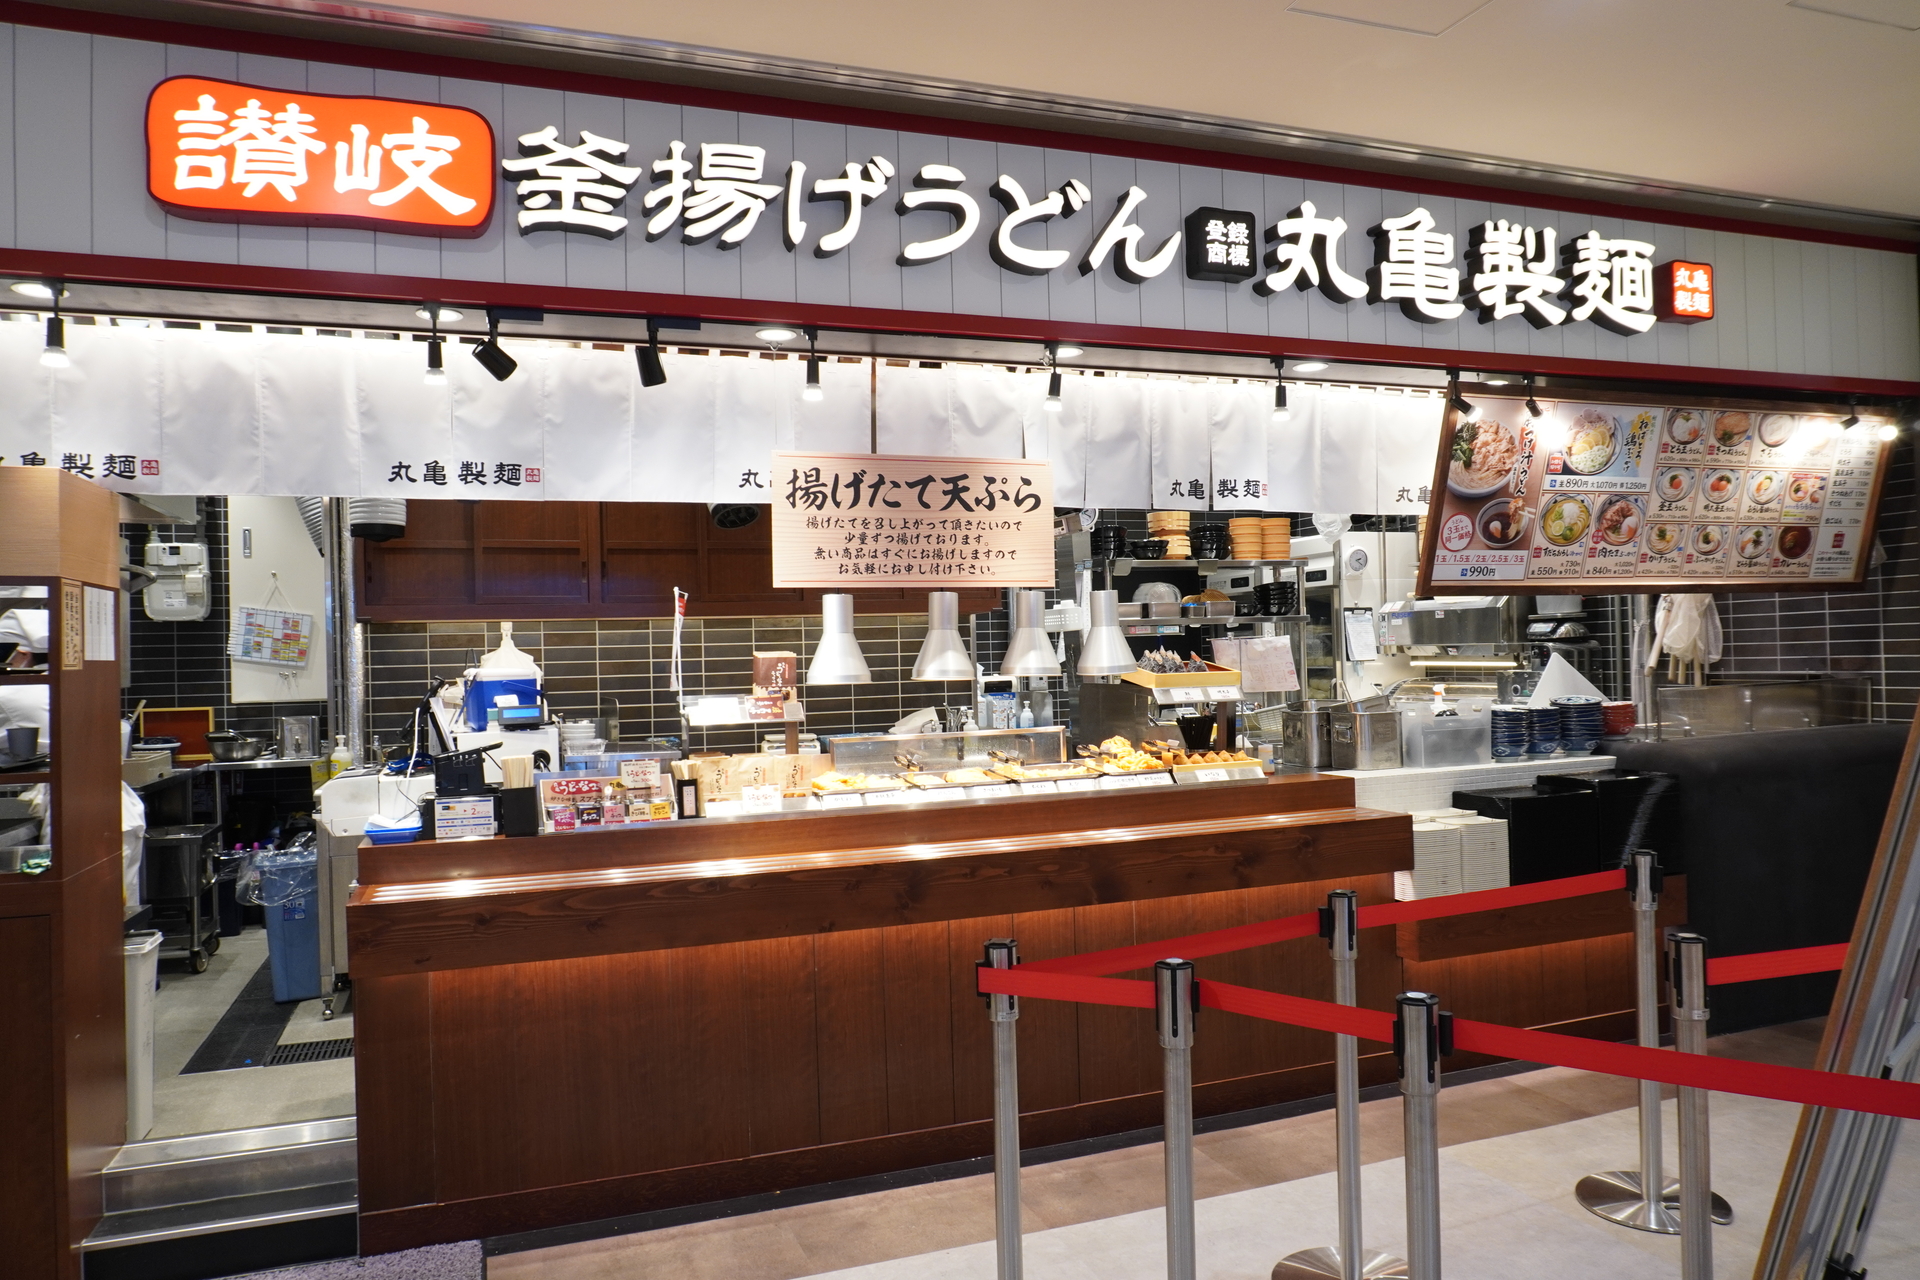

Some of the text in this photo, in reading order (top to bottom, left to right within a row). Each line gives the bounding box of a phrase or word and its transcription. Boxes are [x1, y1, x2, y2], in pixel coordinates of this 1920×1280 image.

[502, 125, 1182, 280] 釜揚げうどん
[1205, 219, 1249, 245] 登録
[1206, 241, 1250, 267] 商標
[1265, 200, 1658, 334] 丸亀製麺
[1674, 267, 1710, 292] 丸亀
[388, 460, 523, 487] 丸亀製麺
[785, 466, 1042, 513] 揚げたて天ぷら
[1169, 478, 1260, 499] 丸亀製麺
[806, 515, 1023, 532] 揚げたてを召し上がって頂きたいので
[844, 531, 990, 548] 少量ずつ揚げております。
[813, 547, 1017, 561] 無い商品はすぐにお揚げしますので
[838, 562, 997, 577] お気軽にお申し付け下さい。
[1469, 566, 1496, 577] 990円
